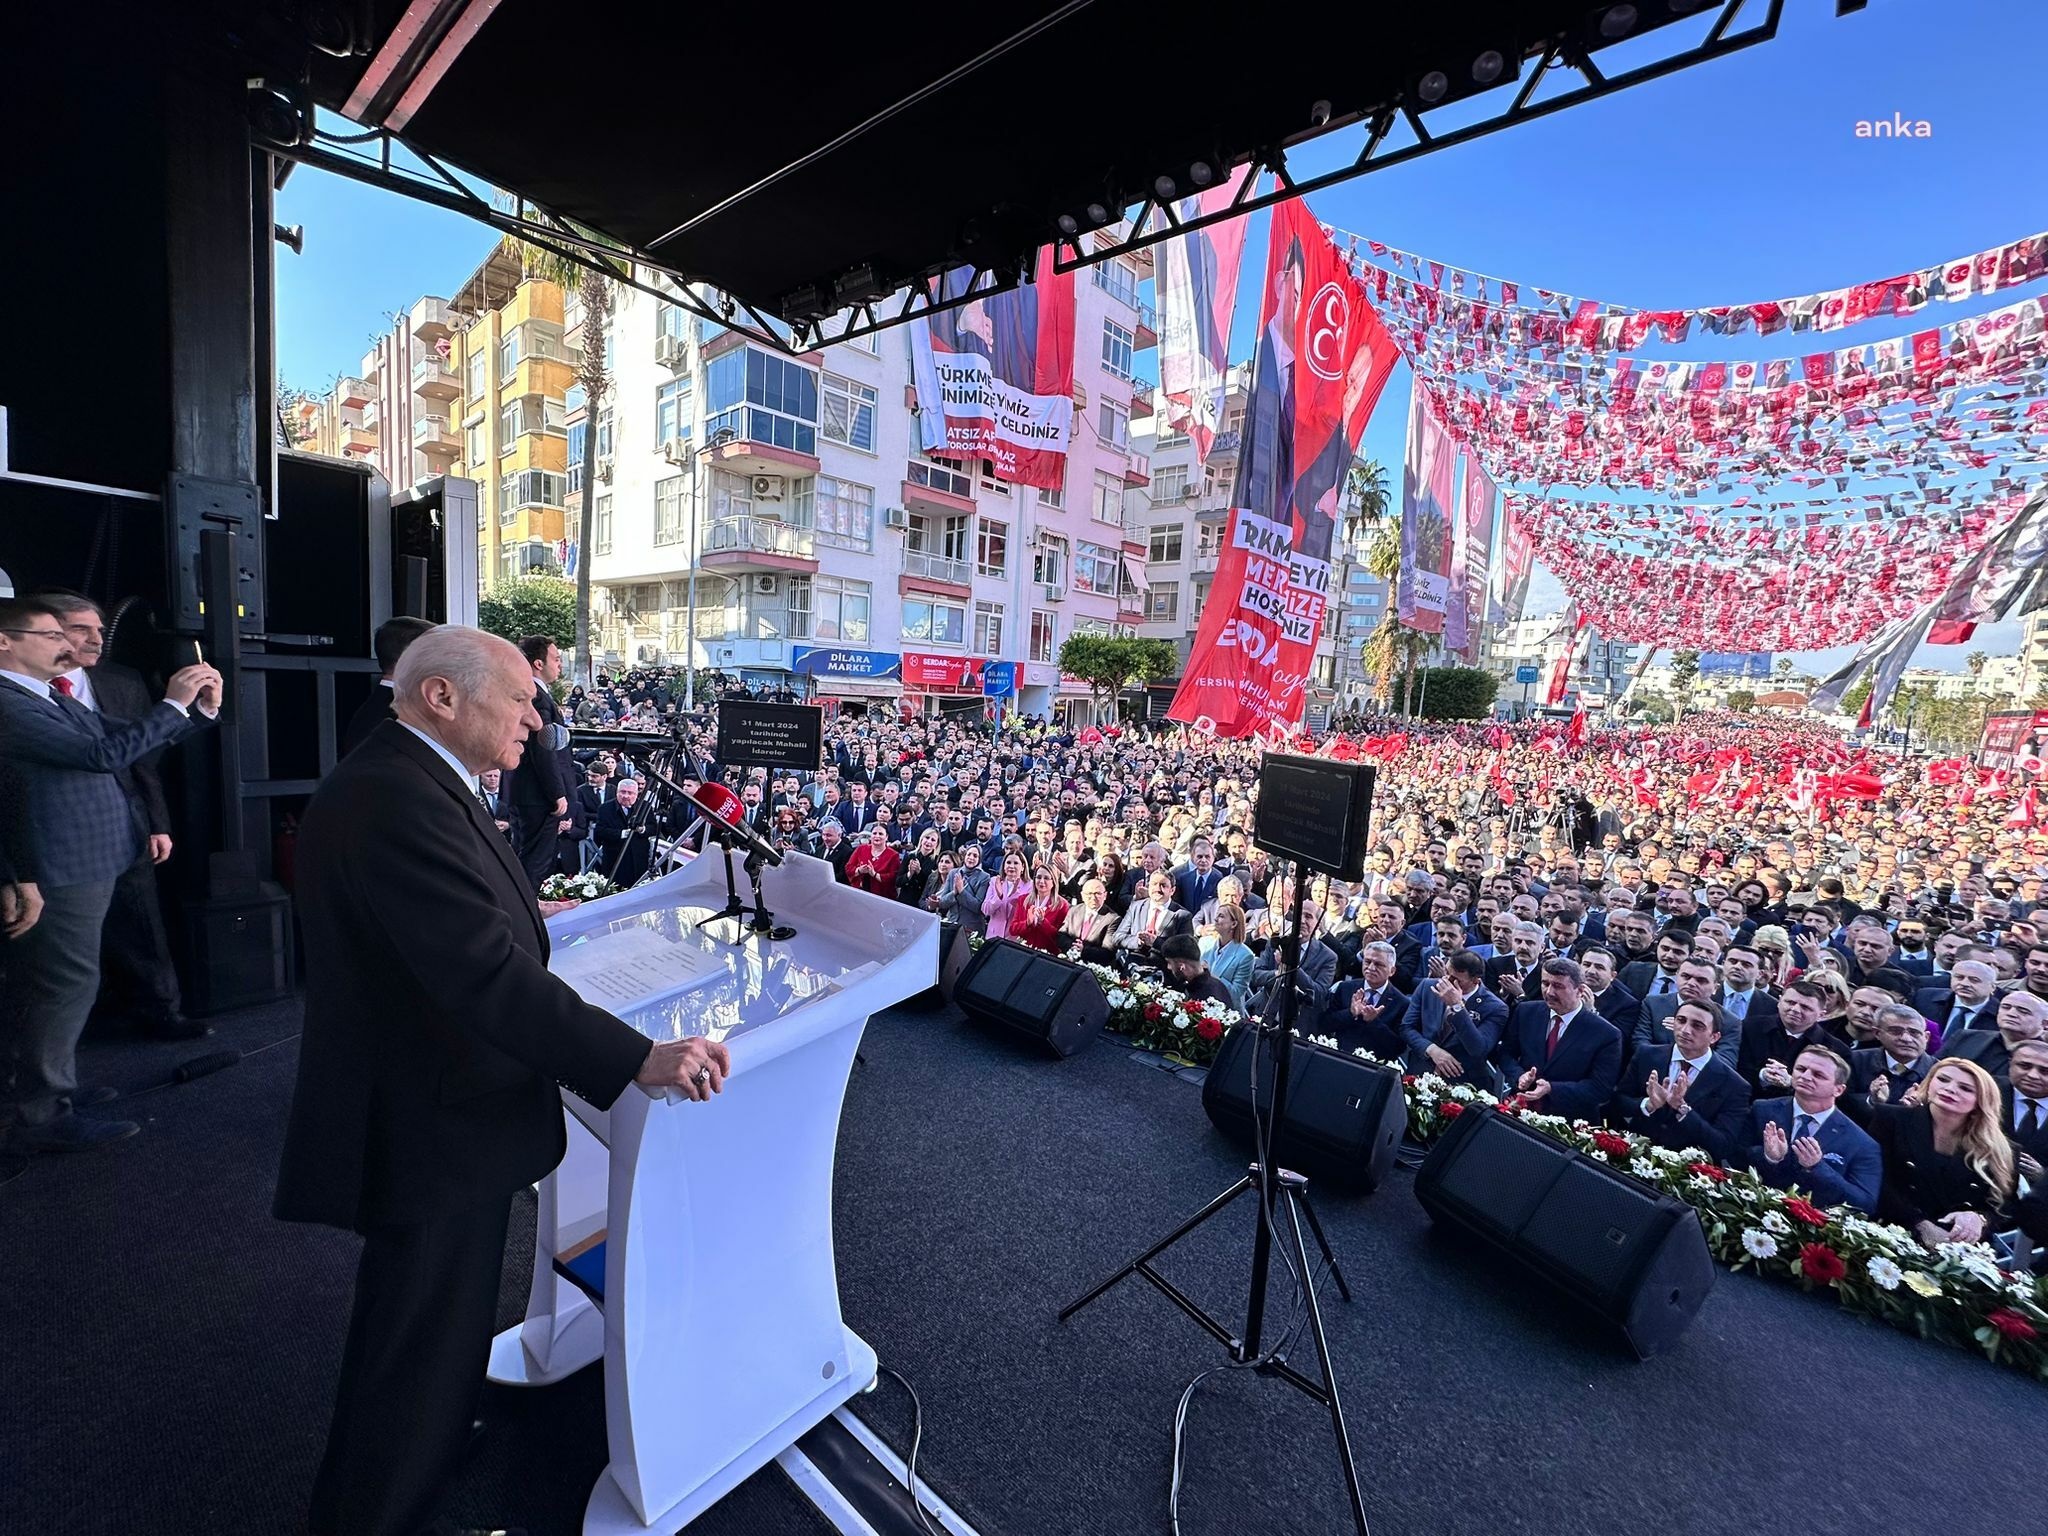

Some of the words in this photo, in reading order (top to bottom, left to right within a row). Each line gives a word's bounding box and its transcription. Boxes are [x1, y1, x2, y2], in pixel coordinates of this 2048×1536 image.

[831, 652, 870, 664] DİLARA
[923, 657, 947, 667] SERDAR
[828, 662, 872, 672] MARKET
[755, 720, 775, 728] Mart
[750, 730, 789, 738] tarihinde
[731, 738, 773, 747] yapılacak
[752, 747, 786, 756] İdareler
